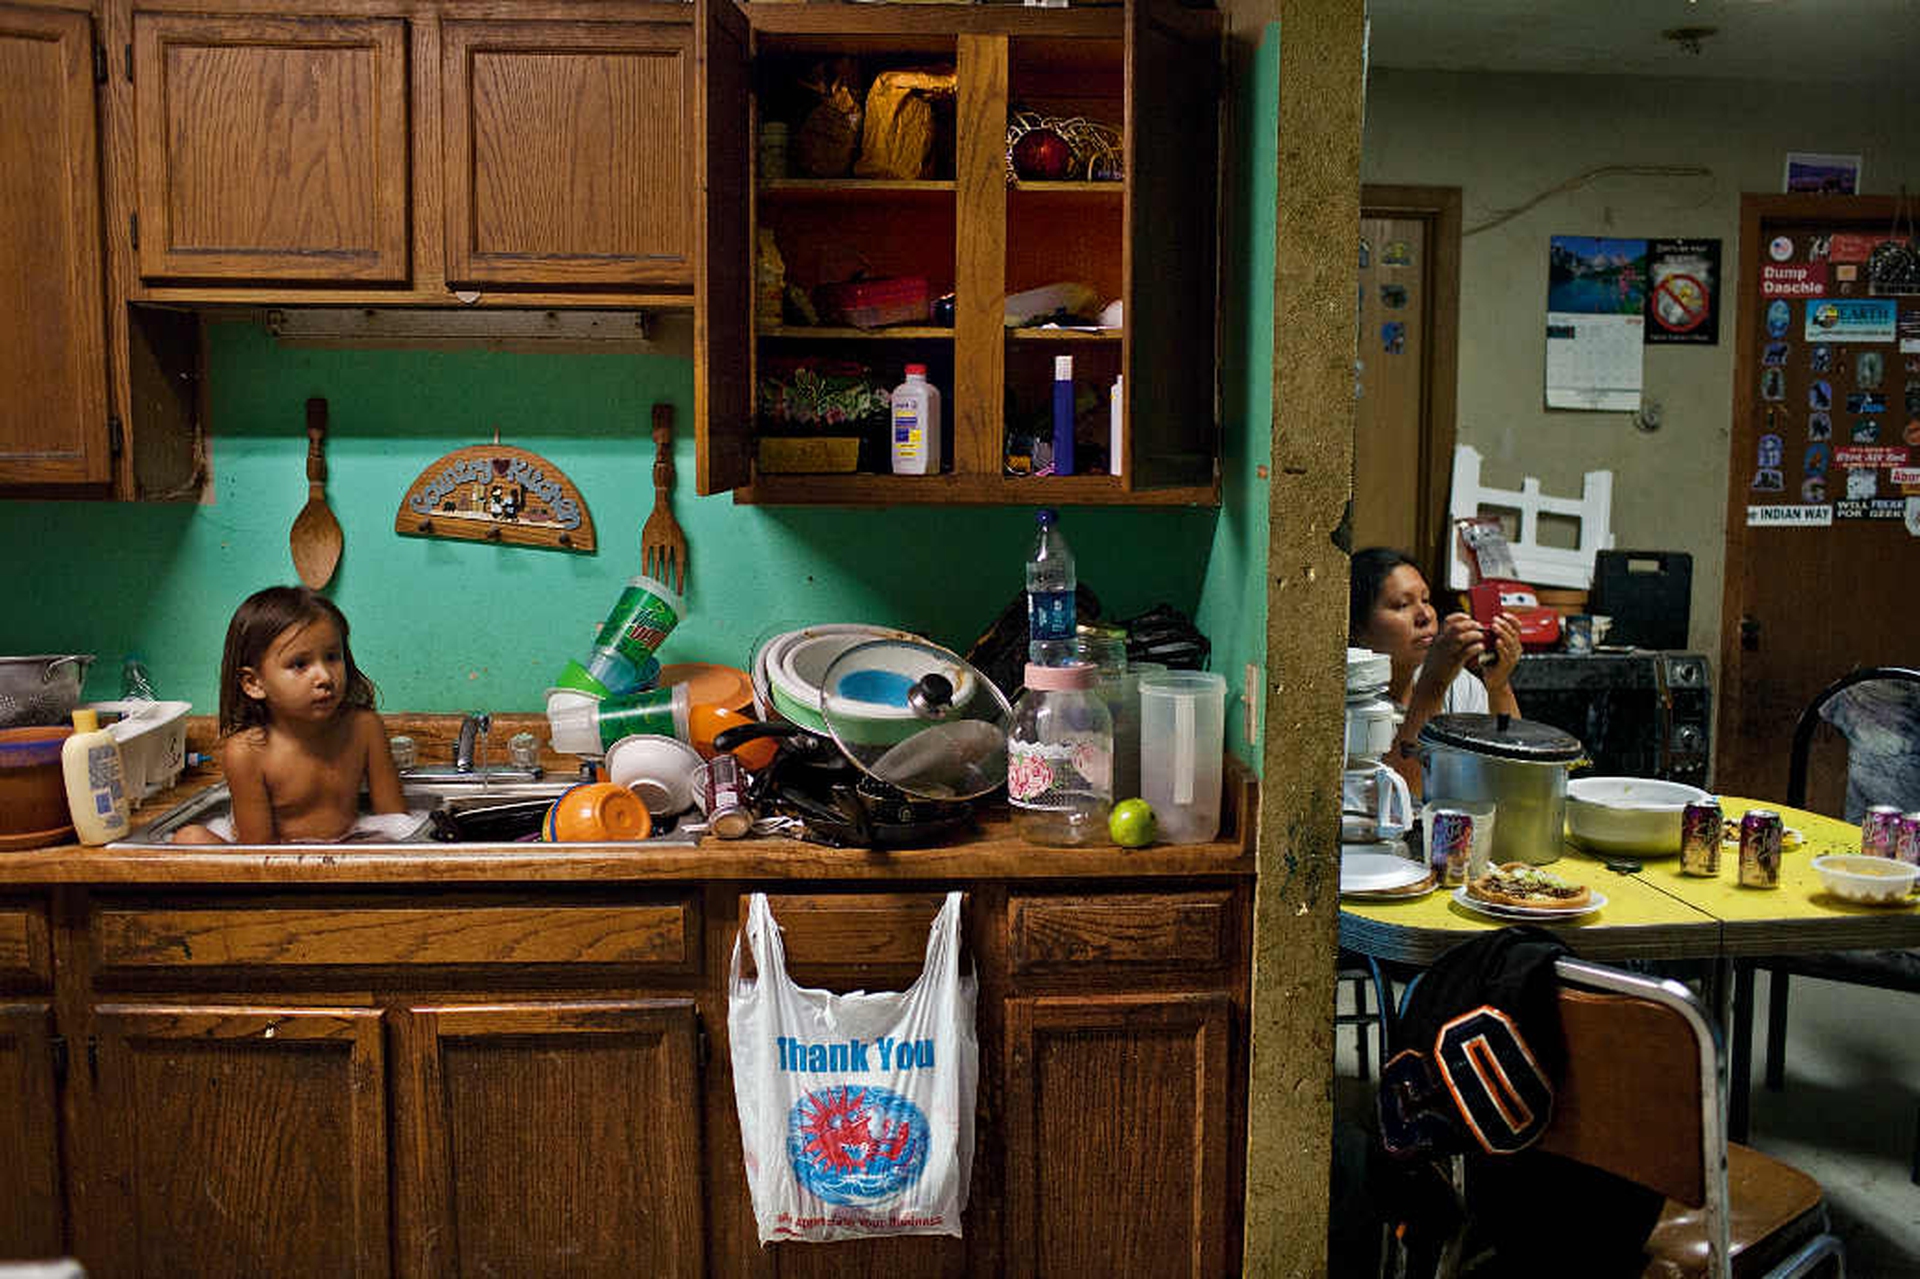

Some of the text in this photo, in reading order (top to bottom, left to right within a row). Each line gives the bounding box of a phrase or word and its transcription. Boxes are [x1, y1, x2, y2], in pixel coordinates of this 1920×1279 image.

[1763, 266, 1808, 281] Dump
[1762, 281, 1824, 295] Daschle
[1760, 508, 1830, 520] INDIAN WAY
[777, 1036, 935, 1073] Thank You
